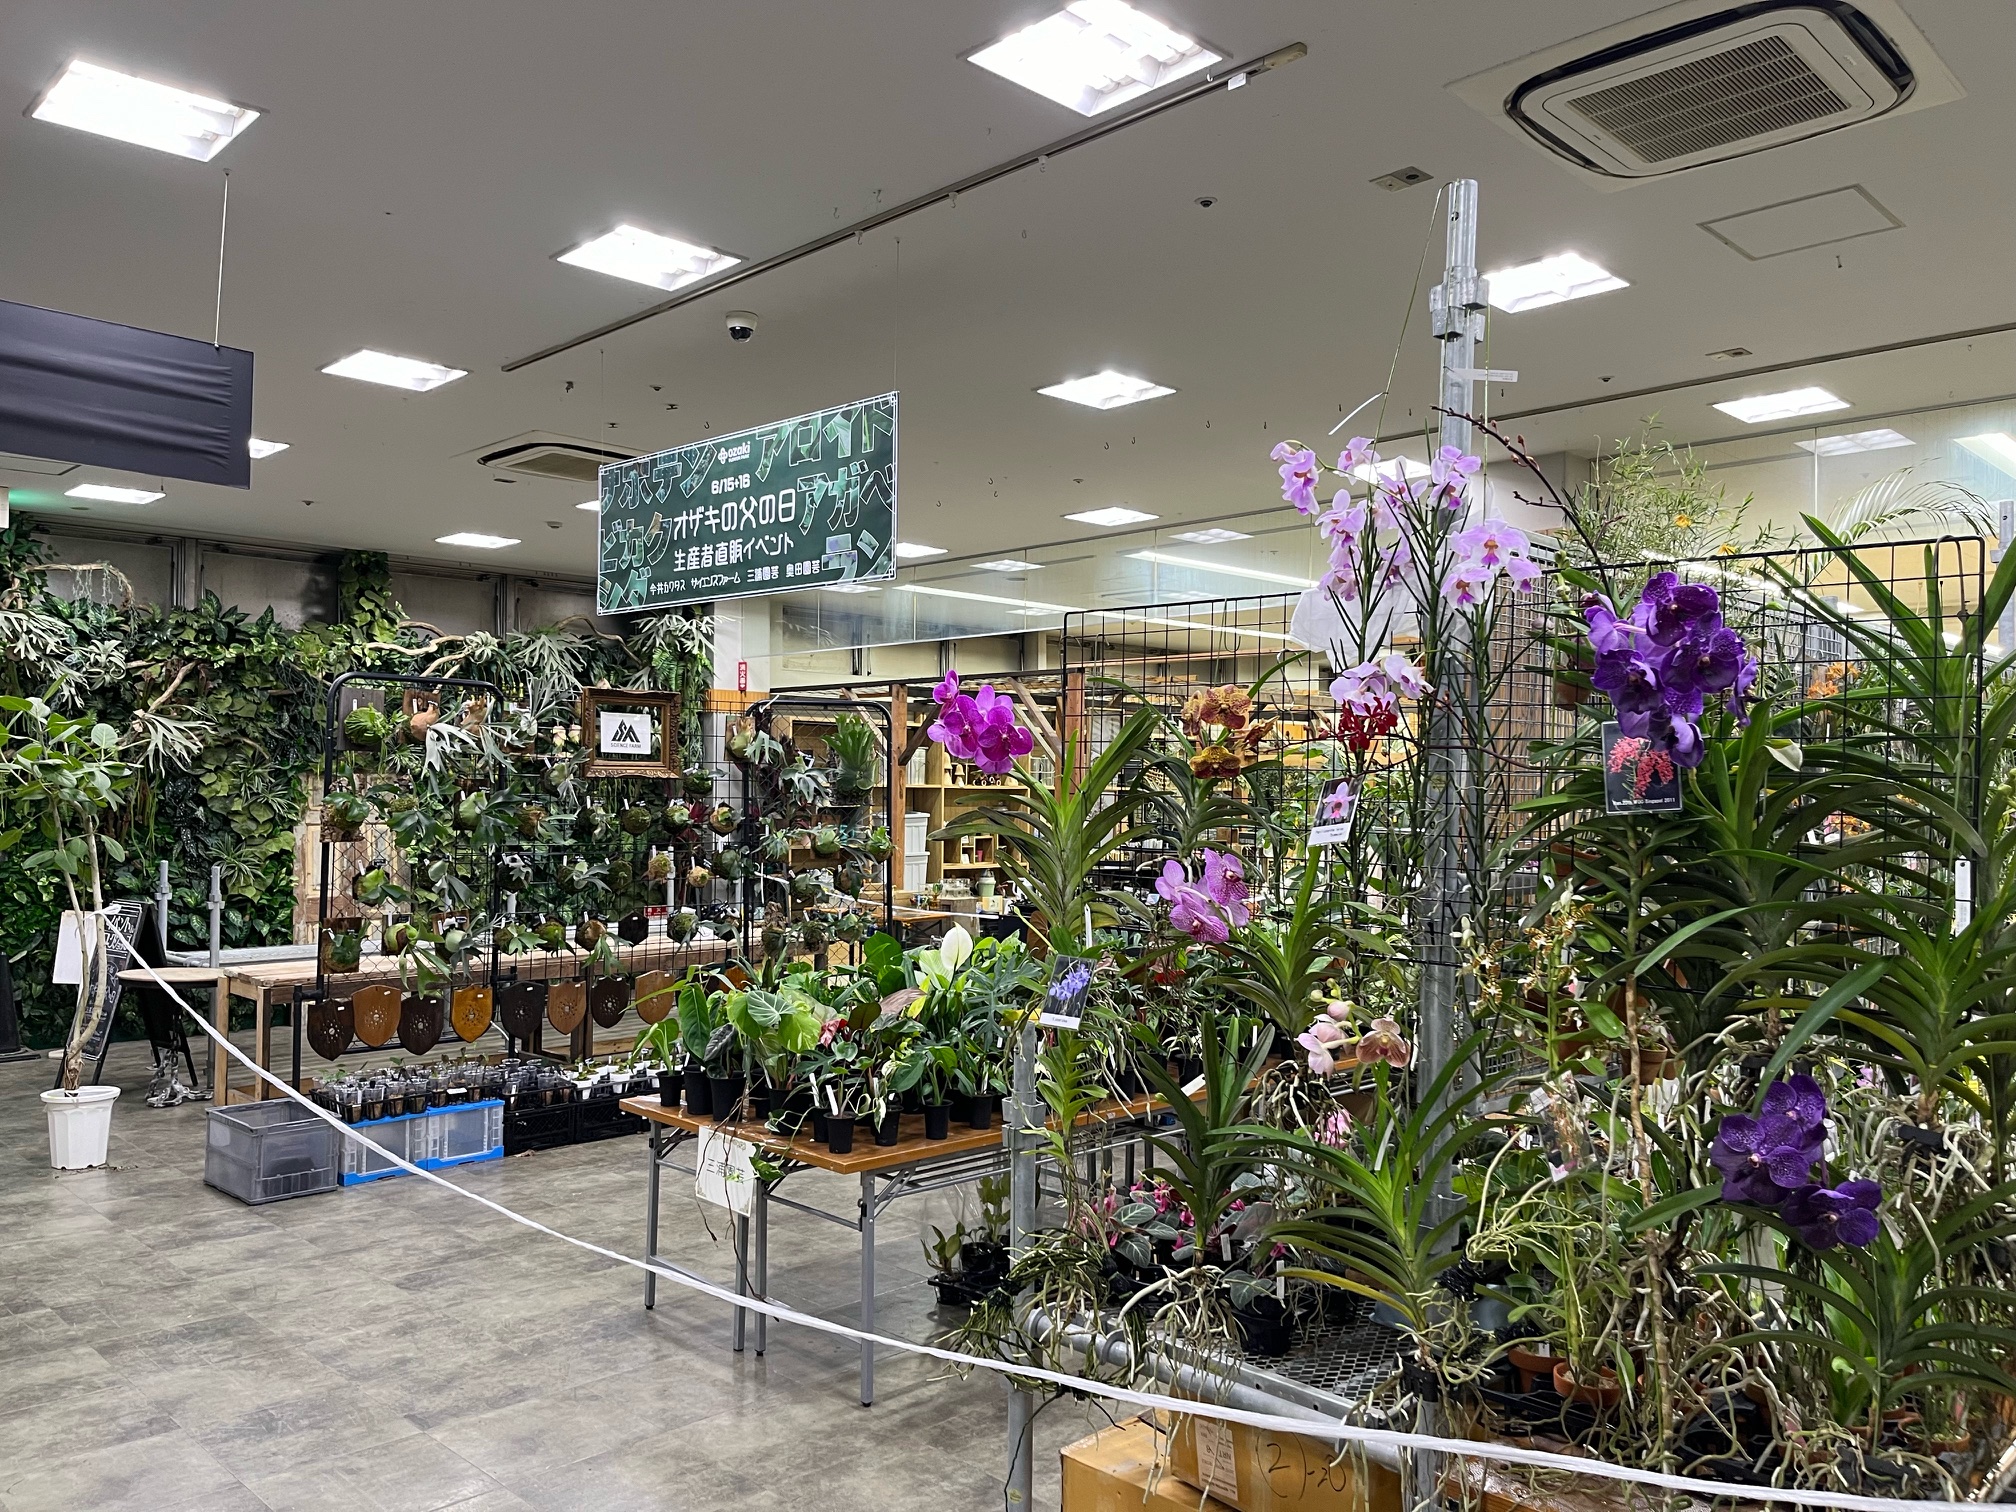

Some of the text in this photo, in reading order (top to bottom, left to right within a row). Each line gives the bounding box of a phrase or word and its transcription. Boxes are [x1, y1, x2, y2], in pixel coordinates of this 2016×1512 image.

[728, 441, 750, 457] ozaki
[673, 488, 796, 540] オザキの父の日
[797, 460, 895, 535] アガベ
[673, 532, 795, 572] 生産者直販イベント
[690, 571, 741, 589] サイエンスファーム
